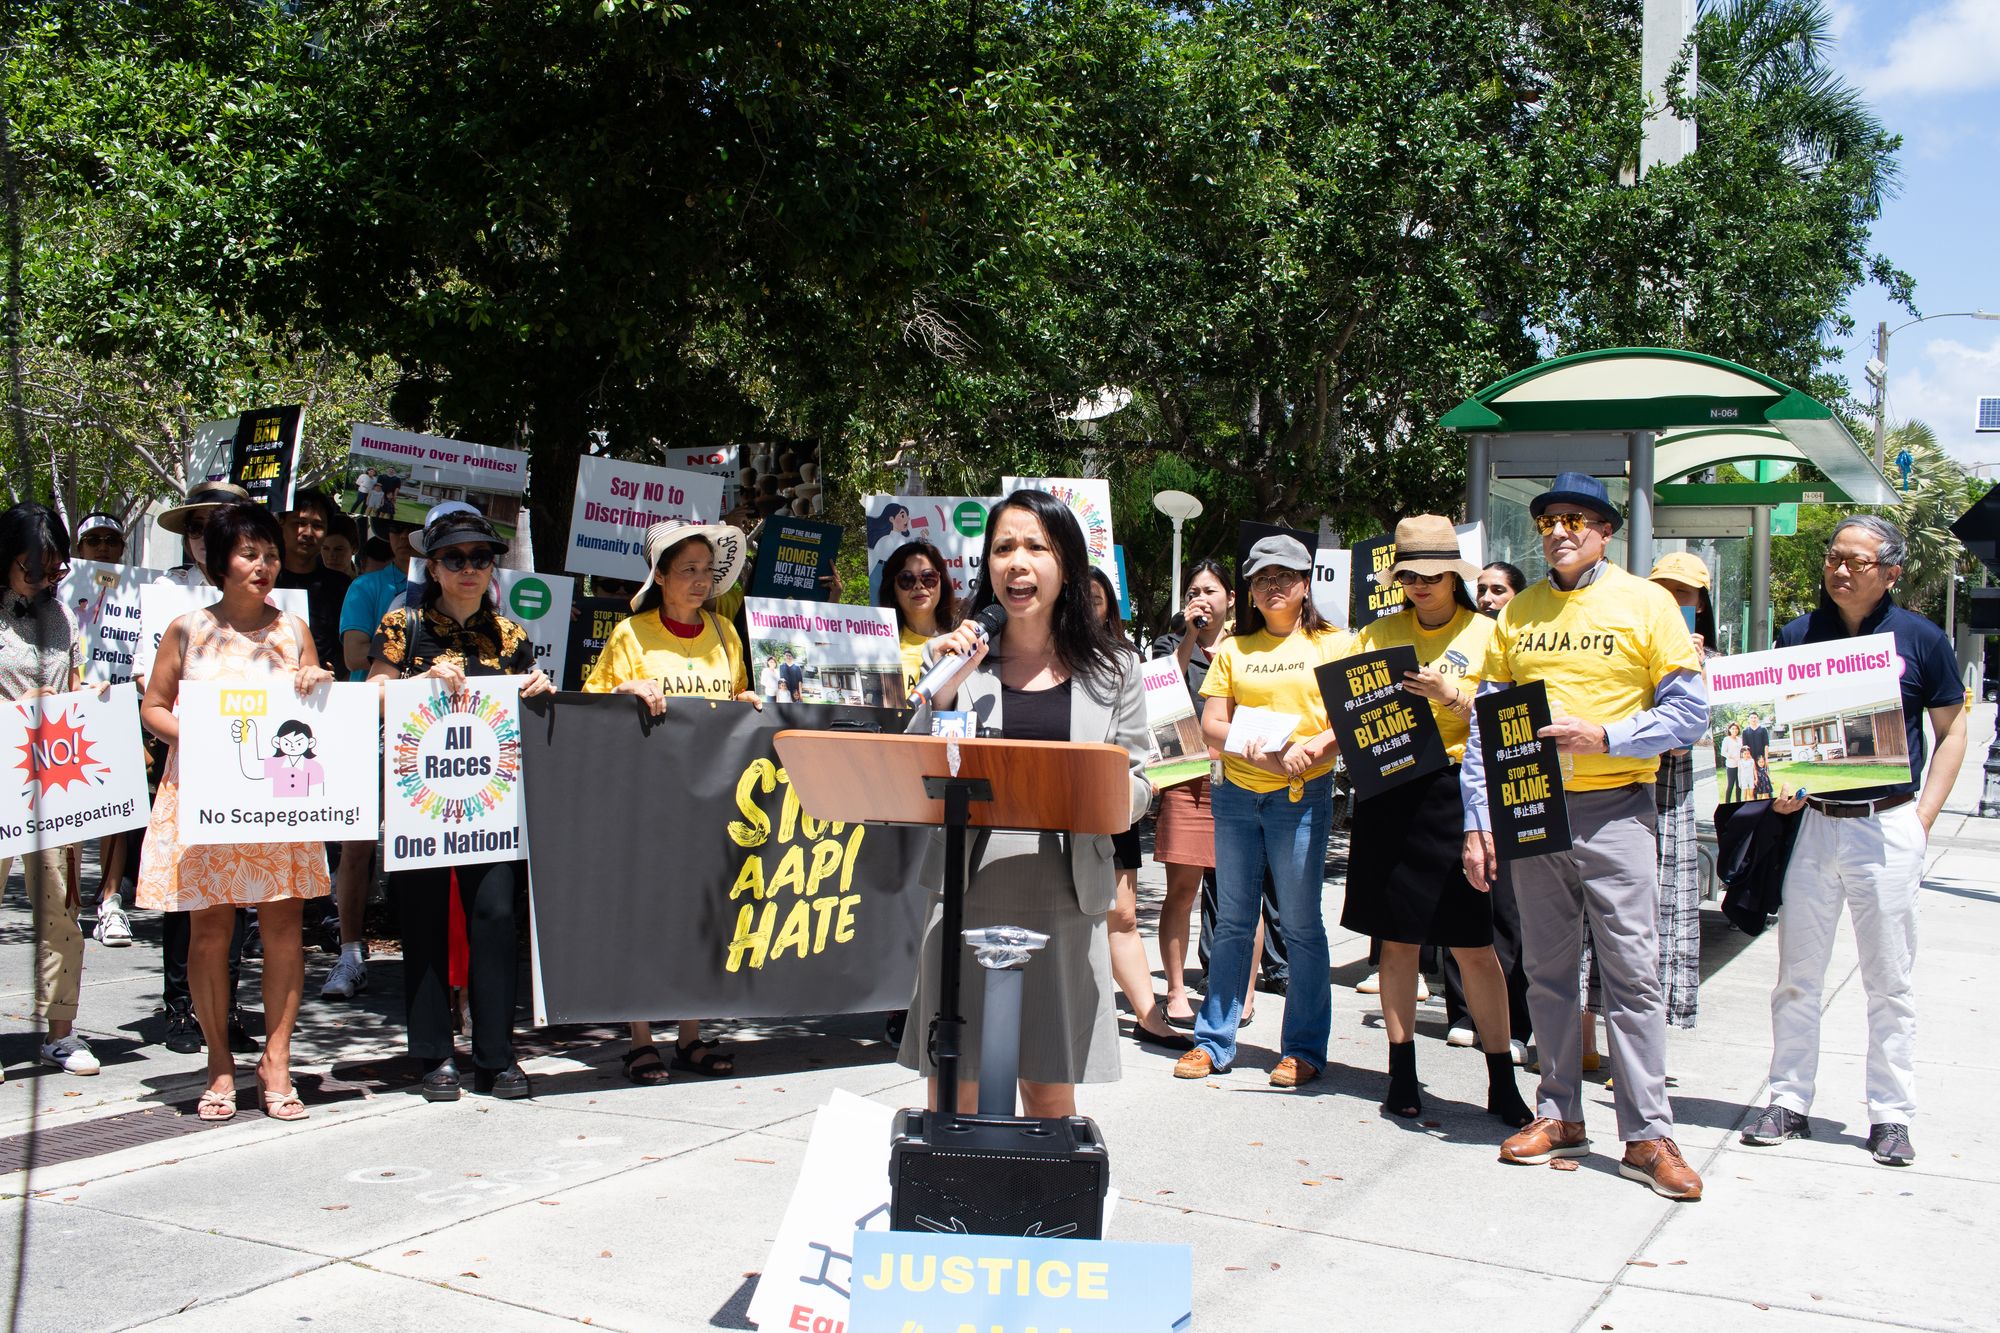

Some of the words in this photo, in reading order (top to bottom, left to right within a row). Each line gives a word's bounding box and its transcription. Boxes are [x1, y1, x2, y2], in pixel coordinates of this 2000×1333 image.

[256, 419, 270, 427] STOP
[1710, 408, 1738, 418] N-064
[253, 425, 280, 443] BAN
[249, 456, 265, 465] STOP
[265, 454, 276, 463] THE
[361, 436, 426, 459] Humanity
[429, 449, 460, 464] Over
[463, 454, 518, 474] Politics!
[687, 453, 726, 466] NO
[241, 462, 281, 481] BLAME
[610, 477, 640, 500] Say
[643, 481, 664, 502] NO
[668, 485, 685, 506] to
[782, 527, 796, 536] STOP
[576, 533, 630, 556] Humanity
[1371, 545, 1388, 557] STOP
[1388, 543, 1397, 553] TH
[777, 545, 819, 567] HOMES
[775, 561, 793, 575] NOT
[794, 564, 817, 579] HATE
[1315, 565, 1335, 582] To
[773, 573, 815, 590] 保护家园
[1368, 588, 1405, 611] BLAM
[105, 603, 121, 617] No
[125, 605, 141, 619] Ne
[593, 610, 613, 620] STOP
[100, 626, 140, 642] Chine
[592, 620, 619, 639] BA
[751, 611, 812, 633] Humanity
[815, 616, 842, 633] Over
[845, 618, 895, 638] Politics!
[532, 643, 552, 658] p!
[1515, 631, 1614, 656] FAAJA.org
[92, 647, 135, 665] Exclus
[1245, 661, 1305, 674] FAAJA.org
[1345, 665, 1369, 679] STOP
[1370, 659, 1387, 671] THE
[1712, 666, 1783, 692] Humanity
[1787, 662, 1822, 681] Over
[1826, 650, 1891, 675] Politics!
[662, 676, 732, 699] AAJA.or
[1143, 669, 1180, 693] litics!
[1348, 668, 1392, 697] BAN
[224, 693, 264, 713] NO!
[1344, 682, 1404, 712] 停止土地禁令
[1360, 707, 1383, 725] STOP
[1383, 700, 1401, 715] THE
[1498, 707, 1516, 721] STOP
[1515, 703, 1529, 715] THE
[445, 726, 472, 750] All
[1353, 707, 1418, 749] BLAME
[1500, 715, 1534, 747] BAN
[31, 731, 80, 772] NO!
[1371, 733, 1412, 757] 停止指责
[1496, 740, 1542, 762] 停止土地禁令
[425, 755, 491, 779] Races
[1507, 766, 1526, 781] STOP
[1526, 763, 1539, 776] THE
[1501, 774, 1552, 807] BLAME
[727, 758, 846, 848] ST
[1513, 802, 1546, 819] 停止指责
[0, 824, 22, 841] No
[26, 798, 135, 834] Scapegoating!
[199, 809, 226, 824] No
[231, 806, 360, 827] Scapegoating!
[394, 835, 436, 859] One
[443, 826, 520, 855] Nation!
[729, 824, 865, 901] AAPI
[725, 894, 861, 973] HATE
[863, 1253, 1109, 1300] JUSTICE
